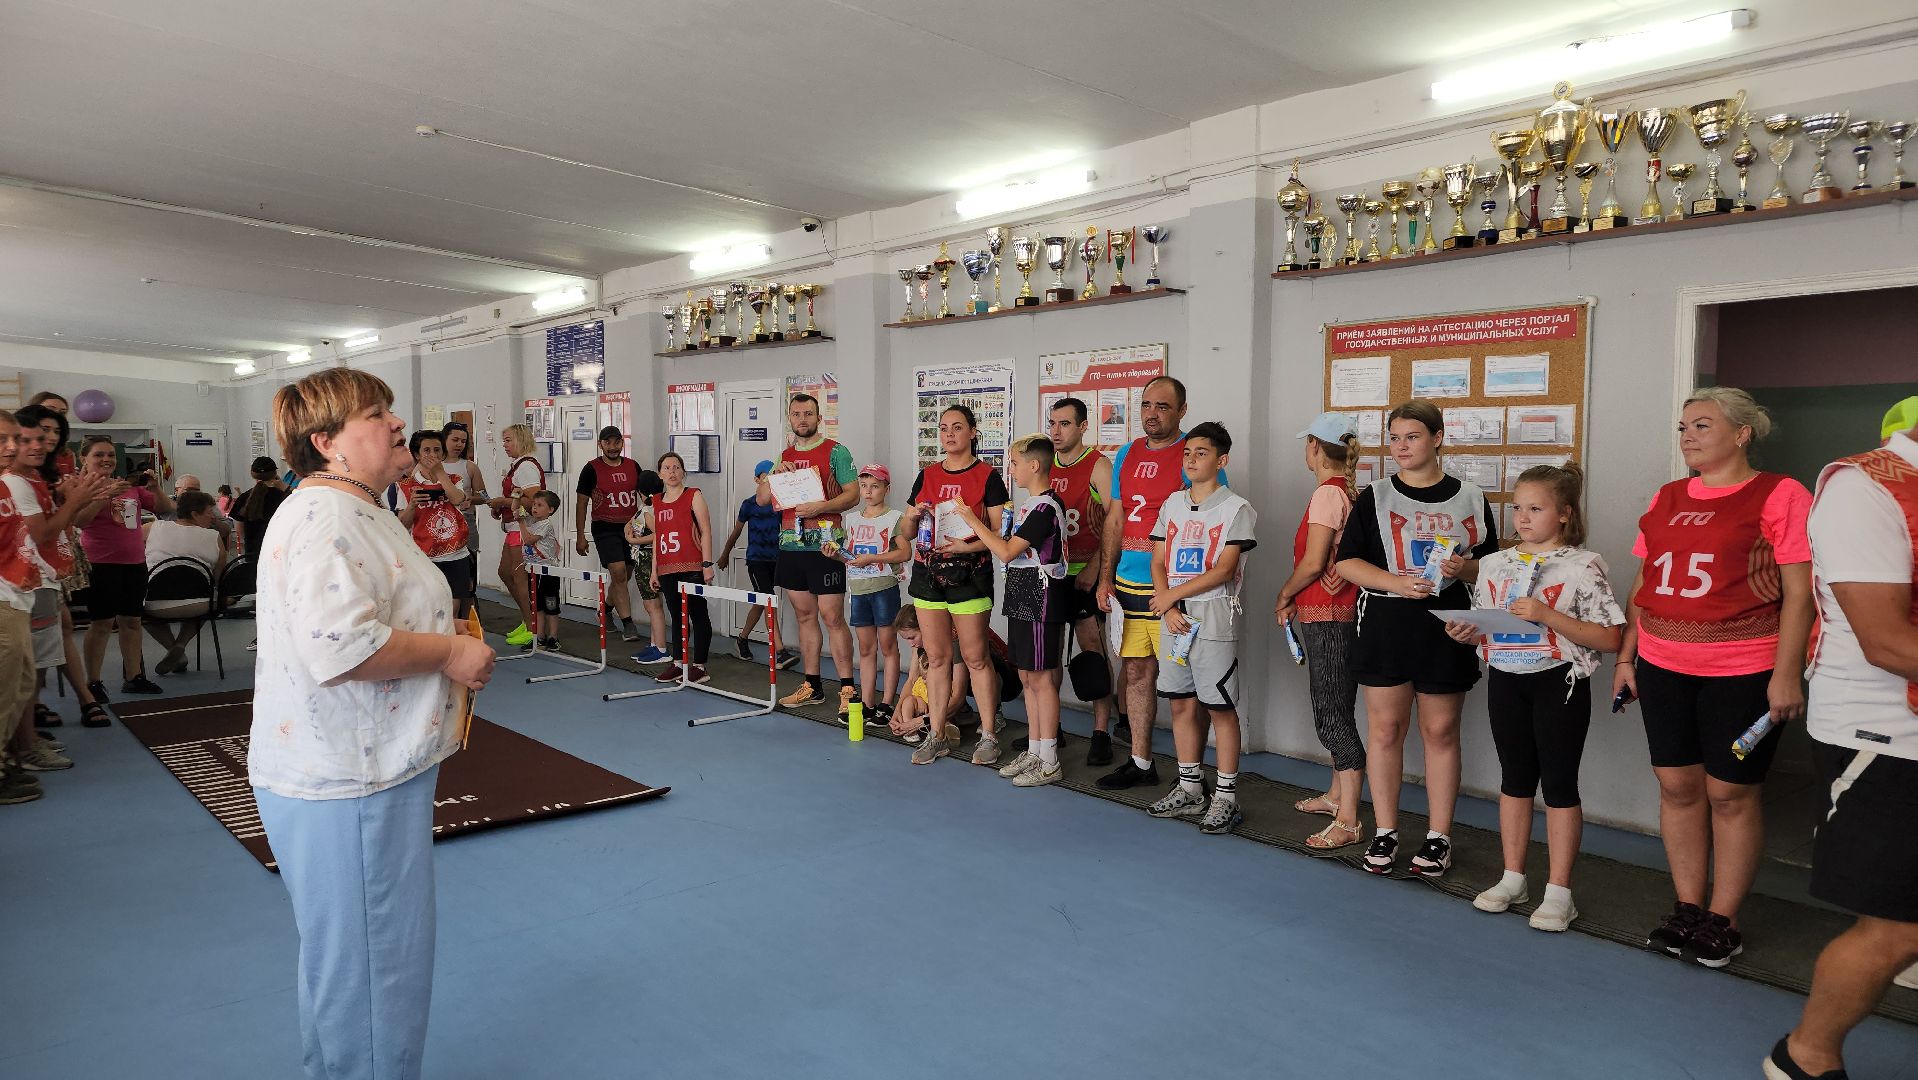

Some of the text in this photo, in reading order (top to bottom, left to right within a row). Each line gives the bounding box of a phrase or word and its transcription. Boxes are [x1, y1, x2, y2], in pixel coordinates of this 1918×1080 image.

[1336, 313, 1570, 341] ПРИЁМ ЗАЯВЛЕНИЙ НА АТТЕСТАЦИЮ ЧЕРЕЗ ПОРТАЛ
[1345, 325, 1558, 349] ГОСУДАРСТВЕННЫХ И МУНИЦИПАЛЬНЫХ УСЛУГ
[612, 472, 627, 483] ГТО
[1133, 461, 1159, 479] ГТО
[658, 508, 674, 523] ГТО
[1128, 493, 1148, 523] 2
[1667, 511, 1716, 526] ГТО
[1414, 510, 1454, 532] ГТО
[660, 531, 681, 555] 65
[1179, 551, 1200, 569] 94
[1653, 551, 1716, 599] 15
